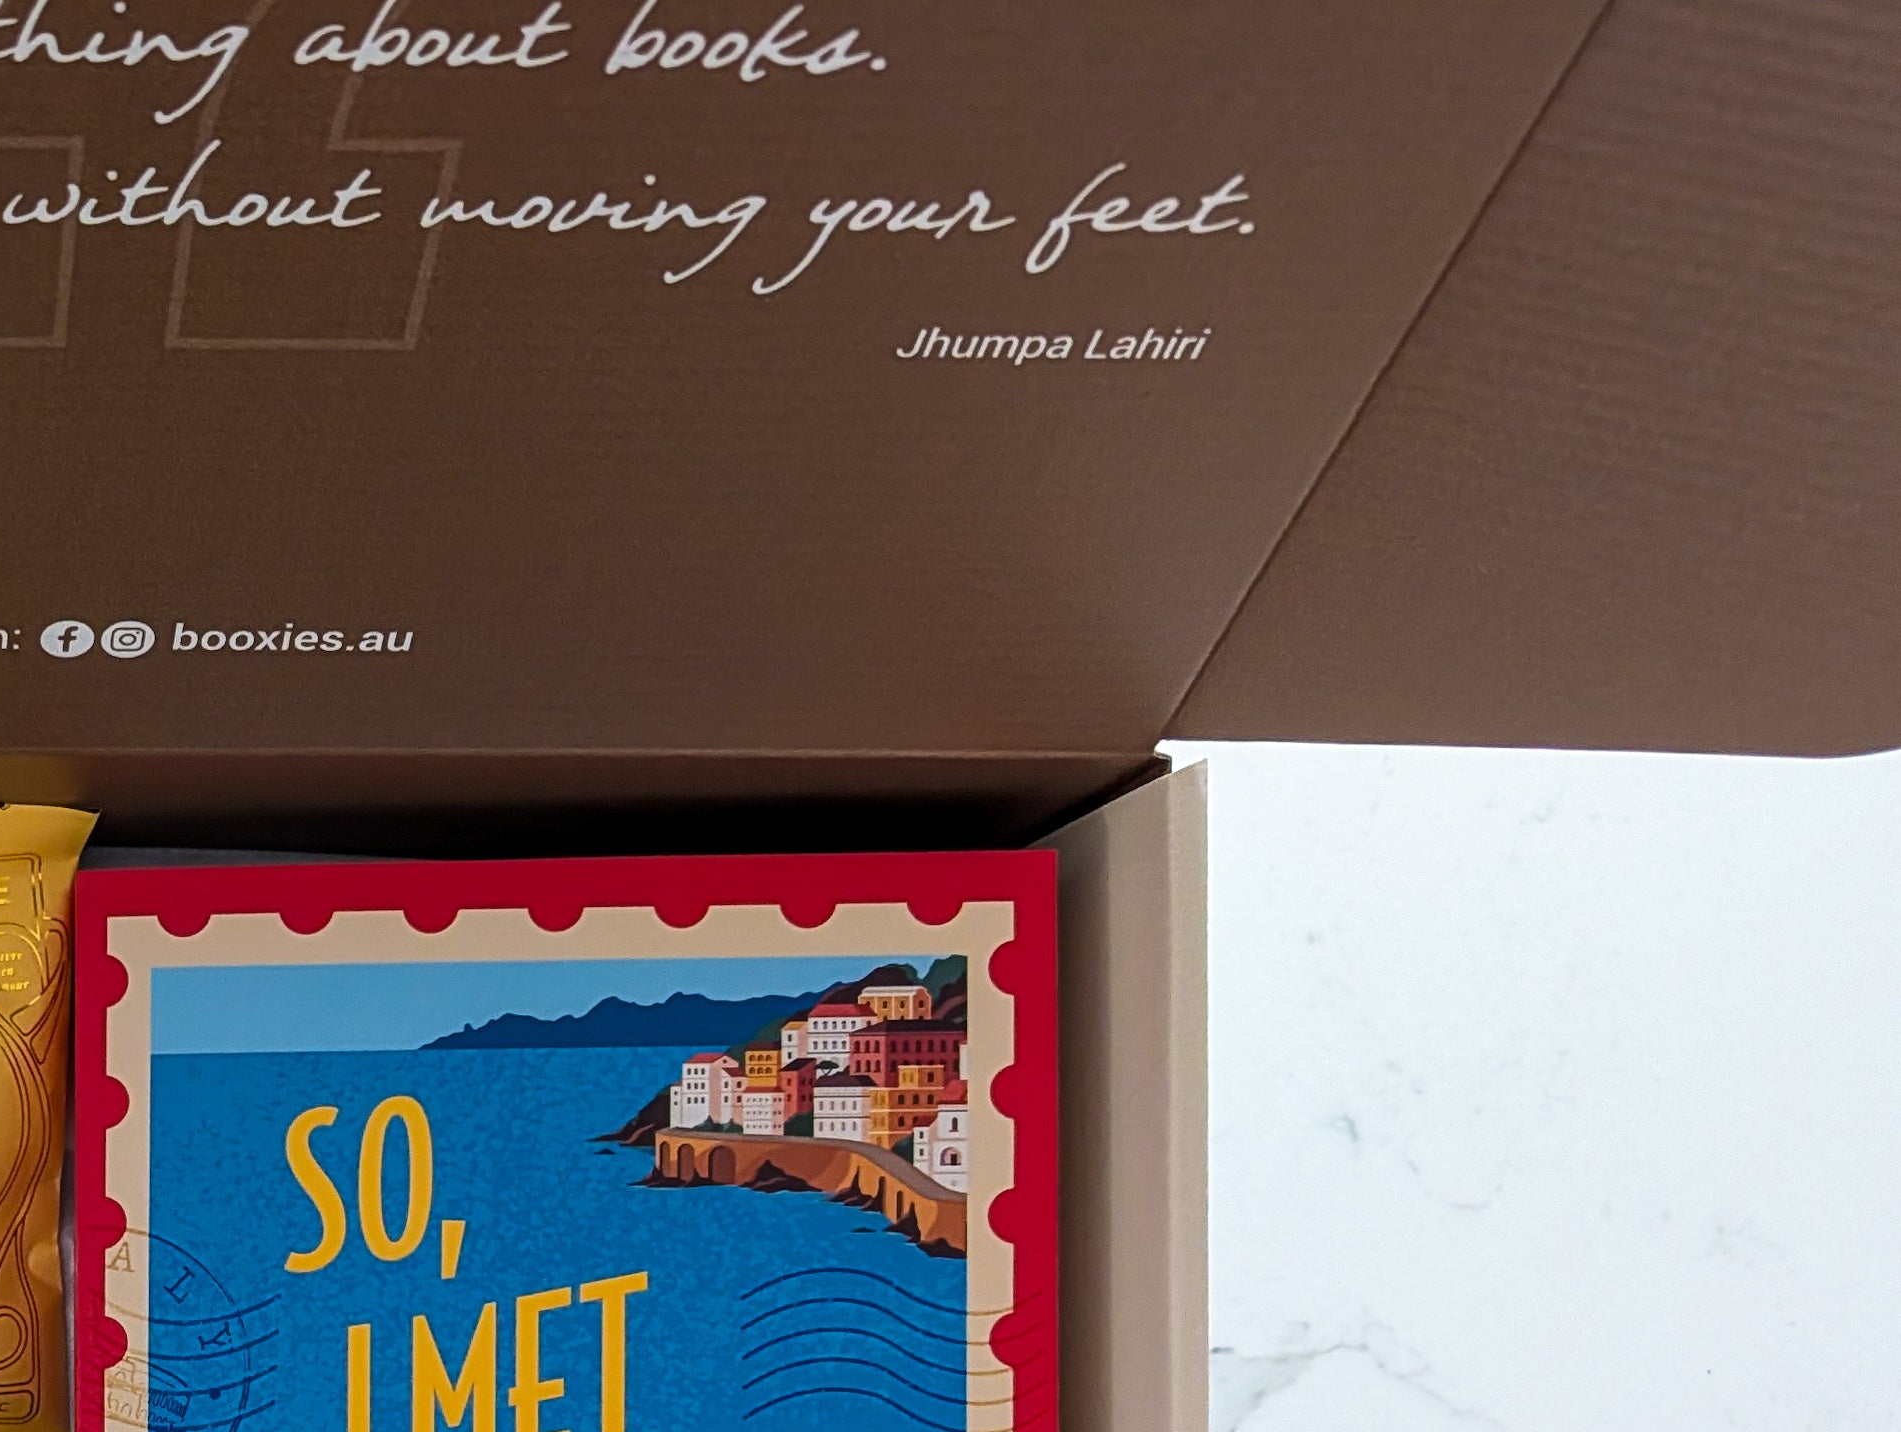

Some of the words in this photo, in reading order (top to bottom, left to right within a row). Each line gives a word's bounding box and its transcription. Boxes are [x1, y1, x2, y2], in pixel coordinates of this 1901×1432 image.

[295, 0, 569, 71] about
[606, 4, 889, 81] books.
[2, 139, 382, 232] without
[421, 174, 766, 284] moving
[753, 196, 1015, 296] your
[1025, 161, 1256, 274] feet.
[897, 326, 1073, 365] Jhumpa
[1085, 326, 1212, 362] Lahiri
[171, 622, 415, 653] booxies.au
[283, 1095, 468, 1281] SO,
